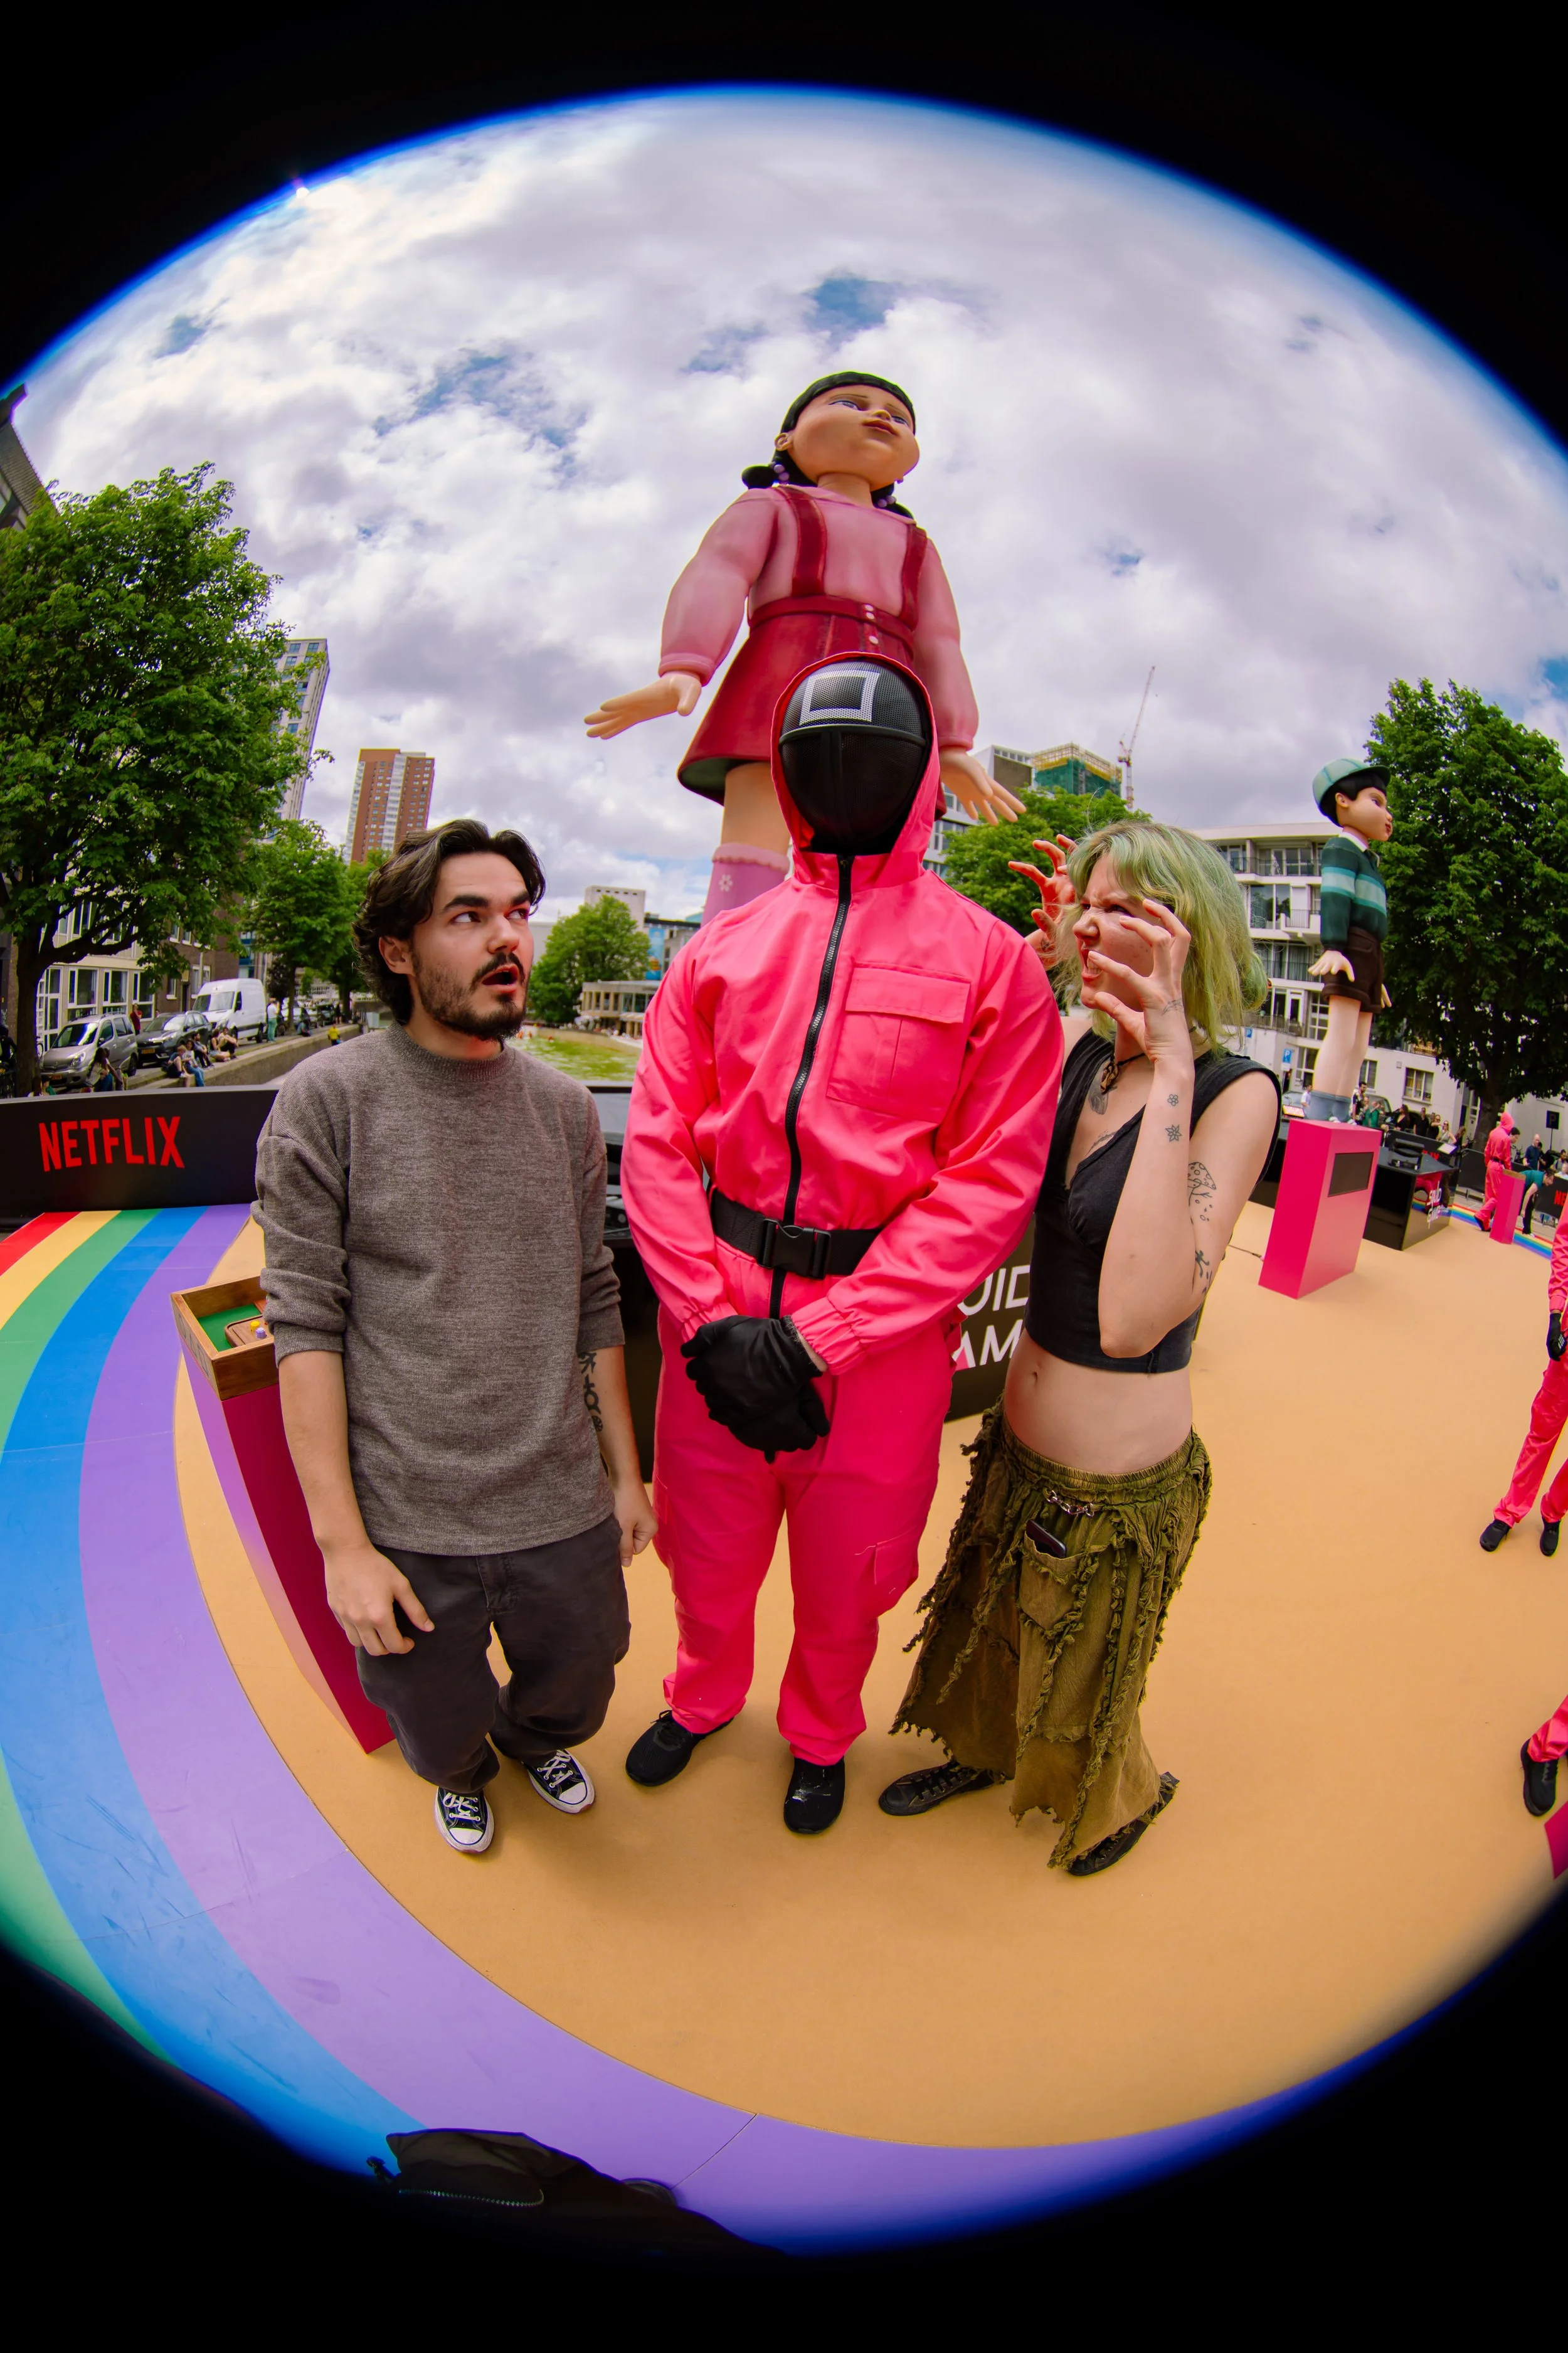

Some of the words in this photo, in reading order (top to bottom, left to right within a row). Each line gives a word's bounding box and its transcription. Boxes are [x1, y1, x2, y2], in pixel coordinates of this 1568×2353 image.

[39, 1116, 185, 1172] NETFLIX
[1554, 1189, 1567, 1206] NE
[957, 1265, 1030, 1315] UID
[951, 1319, 1023, 1368] AM
